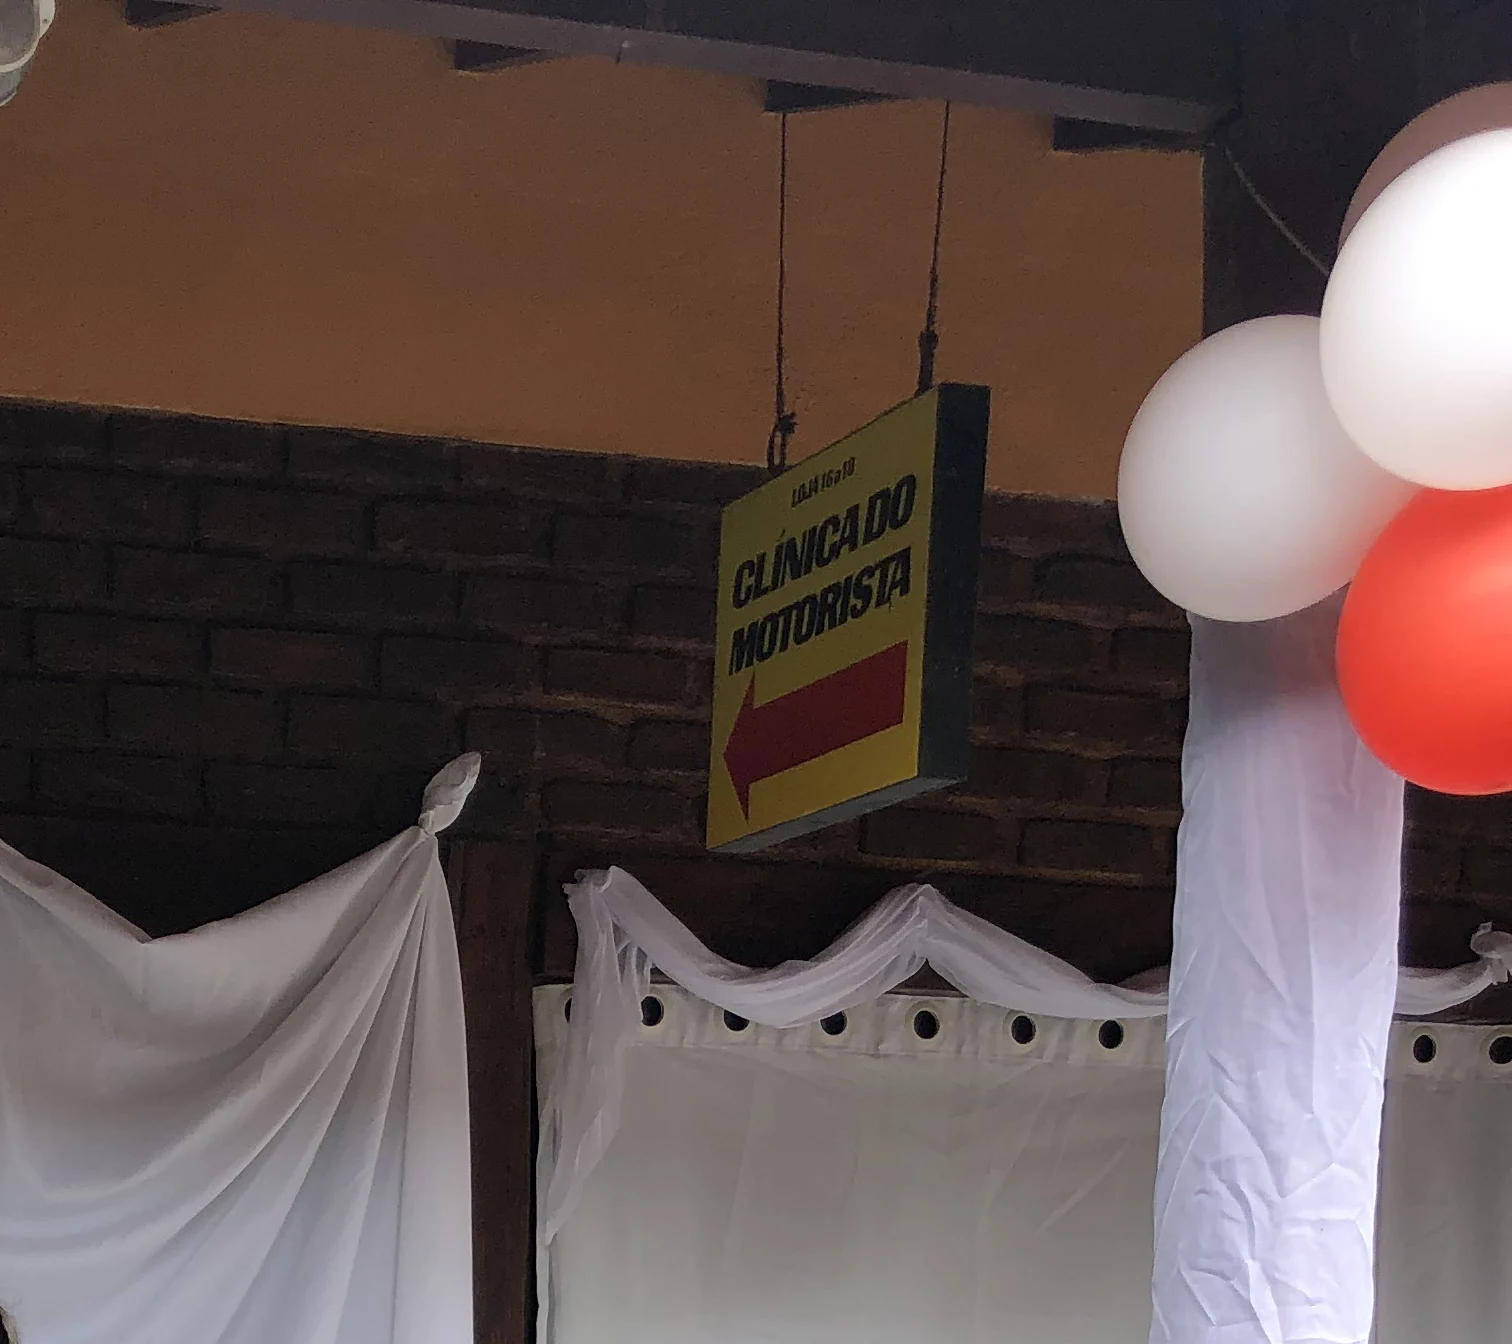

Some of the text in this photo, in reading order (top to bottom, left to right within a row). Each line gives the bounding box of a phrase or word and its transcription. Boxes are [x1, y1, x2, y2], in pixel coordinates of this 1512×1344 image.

[732, 473, 916, 609] CLÍNICA DO
[728, 545, 912, 677] MOTORISTA
